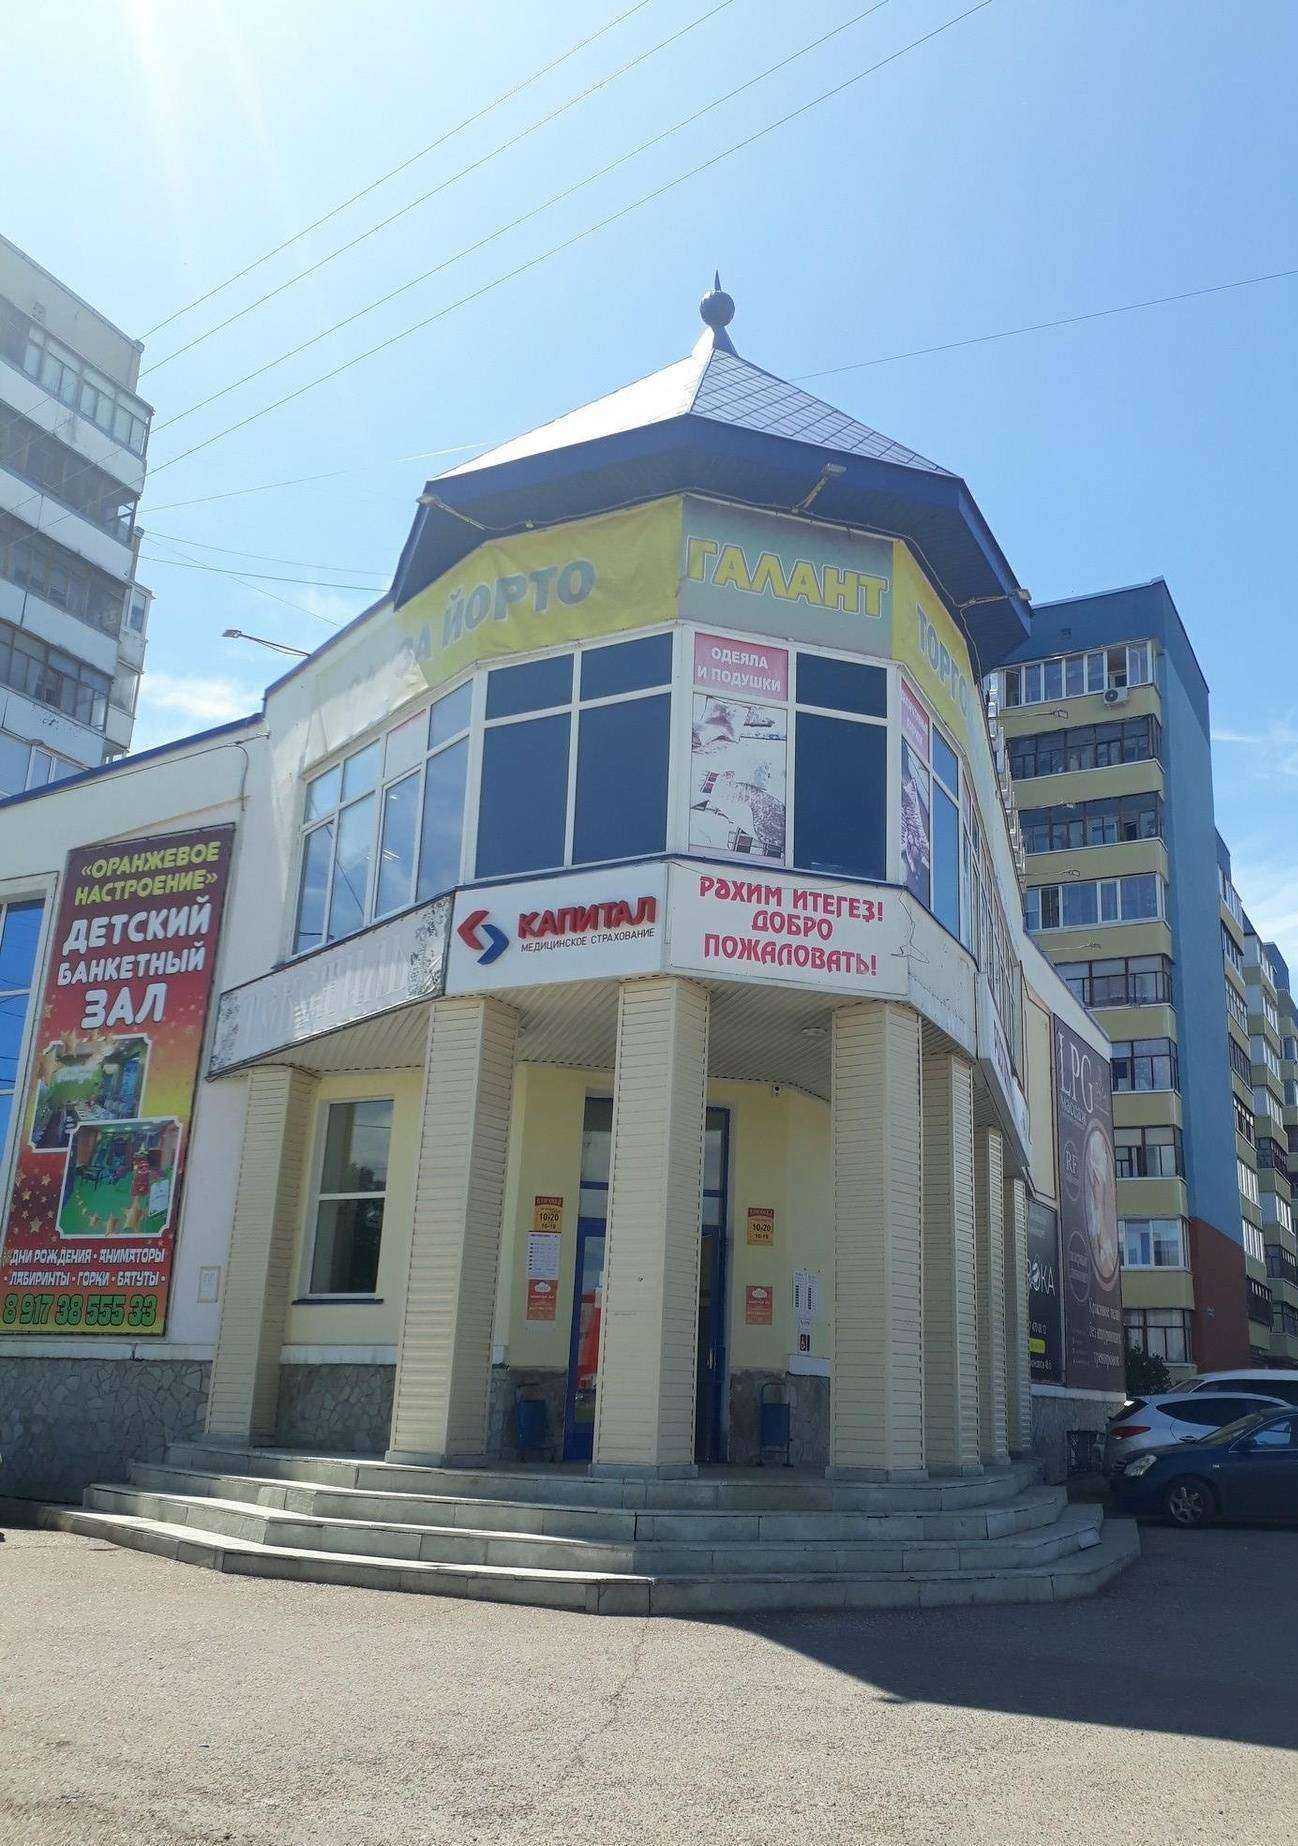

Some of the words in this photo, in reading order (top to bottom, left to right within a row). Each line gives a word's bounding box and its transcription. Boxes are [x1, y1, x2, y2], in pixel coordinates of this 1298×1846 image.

[686, 536, 888, 618] ГАЛАНТ
[441, 558, 597, 651] ЙОРТО
[711, 647, 769, 670] ОДЕЯЛА
[697, 664, 709, 679] И
[712, 668, 782, 692] ПОДУШКИ
[81, 841, 222, 879] «ОРАНЖЕВОЕ
[74, 868, 219, 906] НАСТРОЕНИЕ»
[62, 895, 212, 957] ДЕТСКИЙ
[518, 896, 656, 939] КАПИТАЛ
[752, 910, 833, 940] ДОБРО
[521, 936, 587, 953] МЕДИЦИНСКОЕ
[590, 927, 656, 945] СТРАХОВАНИЕ
[705, 933, 877, 976] ПОЖАЛОВАТЬ!
[57, 941, 206, 986] БАНКЕТНЫЙ
[80, 982, 169, 1029] ЗАЛ
[10, 1249, 32, 1265] ДНИ
[34, 1249, 92, 1266] РОЖДЕНИЯ
[99, 1249, 165, 1263] АНИМАТОРЫ
[9, 1271, 70, 1286] ЛАБИРИНТЫ
[77, 1271, 110, 1286] ГОРКИ
[117, 1271, 160, 1286] БАТУТЫ
[3, 1293, 18, 1324] 8
[19, 1293, 55, 1324] 917
[85, 1294, 127, 1326] 555
